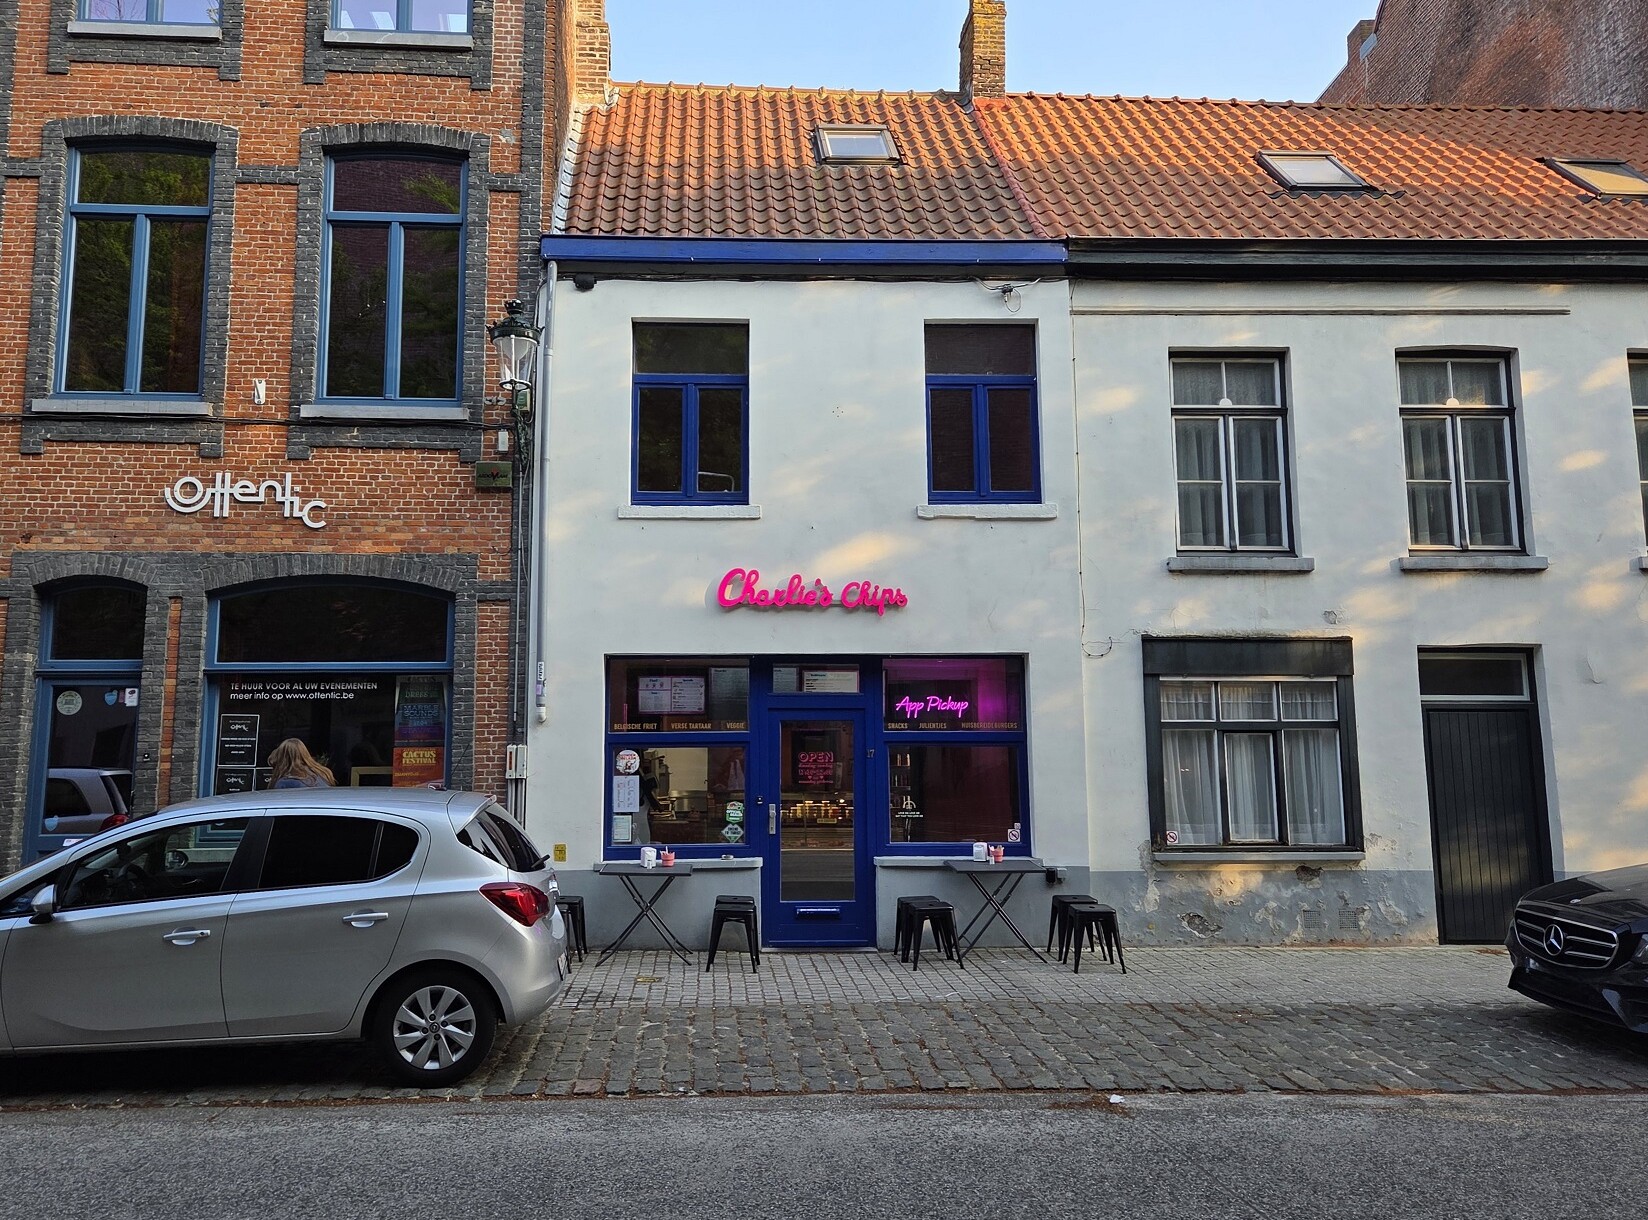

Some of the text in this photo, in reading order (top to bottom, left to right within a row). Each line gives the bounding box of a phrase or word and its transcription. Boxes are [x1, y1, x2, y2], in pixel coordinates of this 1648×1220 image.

[717, 567, 909, 617] Charlie's Chips
[230, 682, 378, 690] TE HUUR VOOR AL UW EVENEMENTEN
[254, 691, 270, 699] info
[271, 693, 284, 701] op
[895, 695, 969, 719] App Pickup
[402, 750, 437, 758] CACTUS
[798, 751, 834, 762] OPEN
[866, 749, 875, 758] 17
